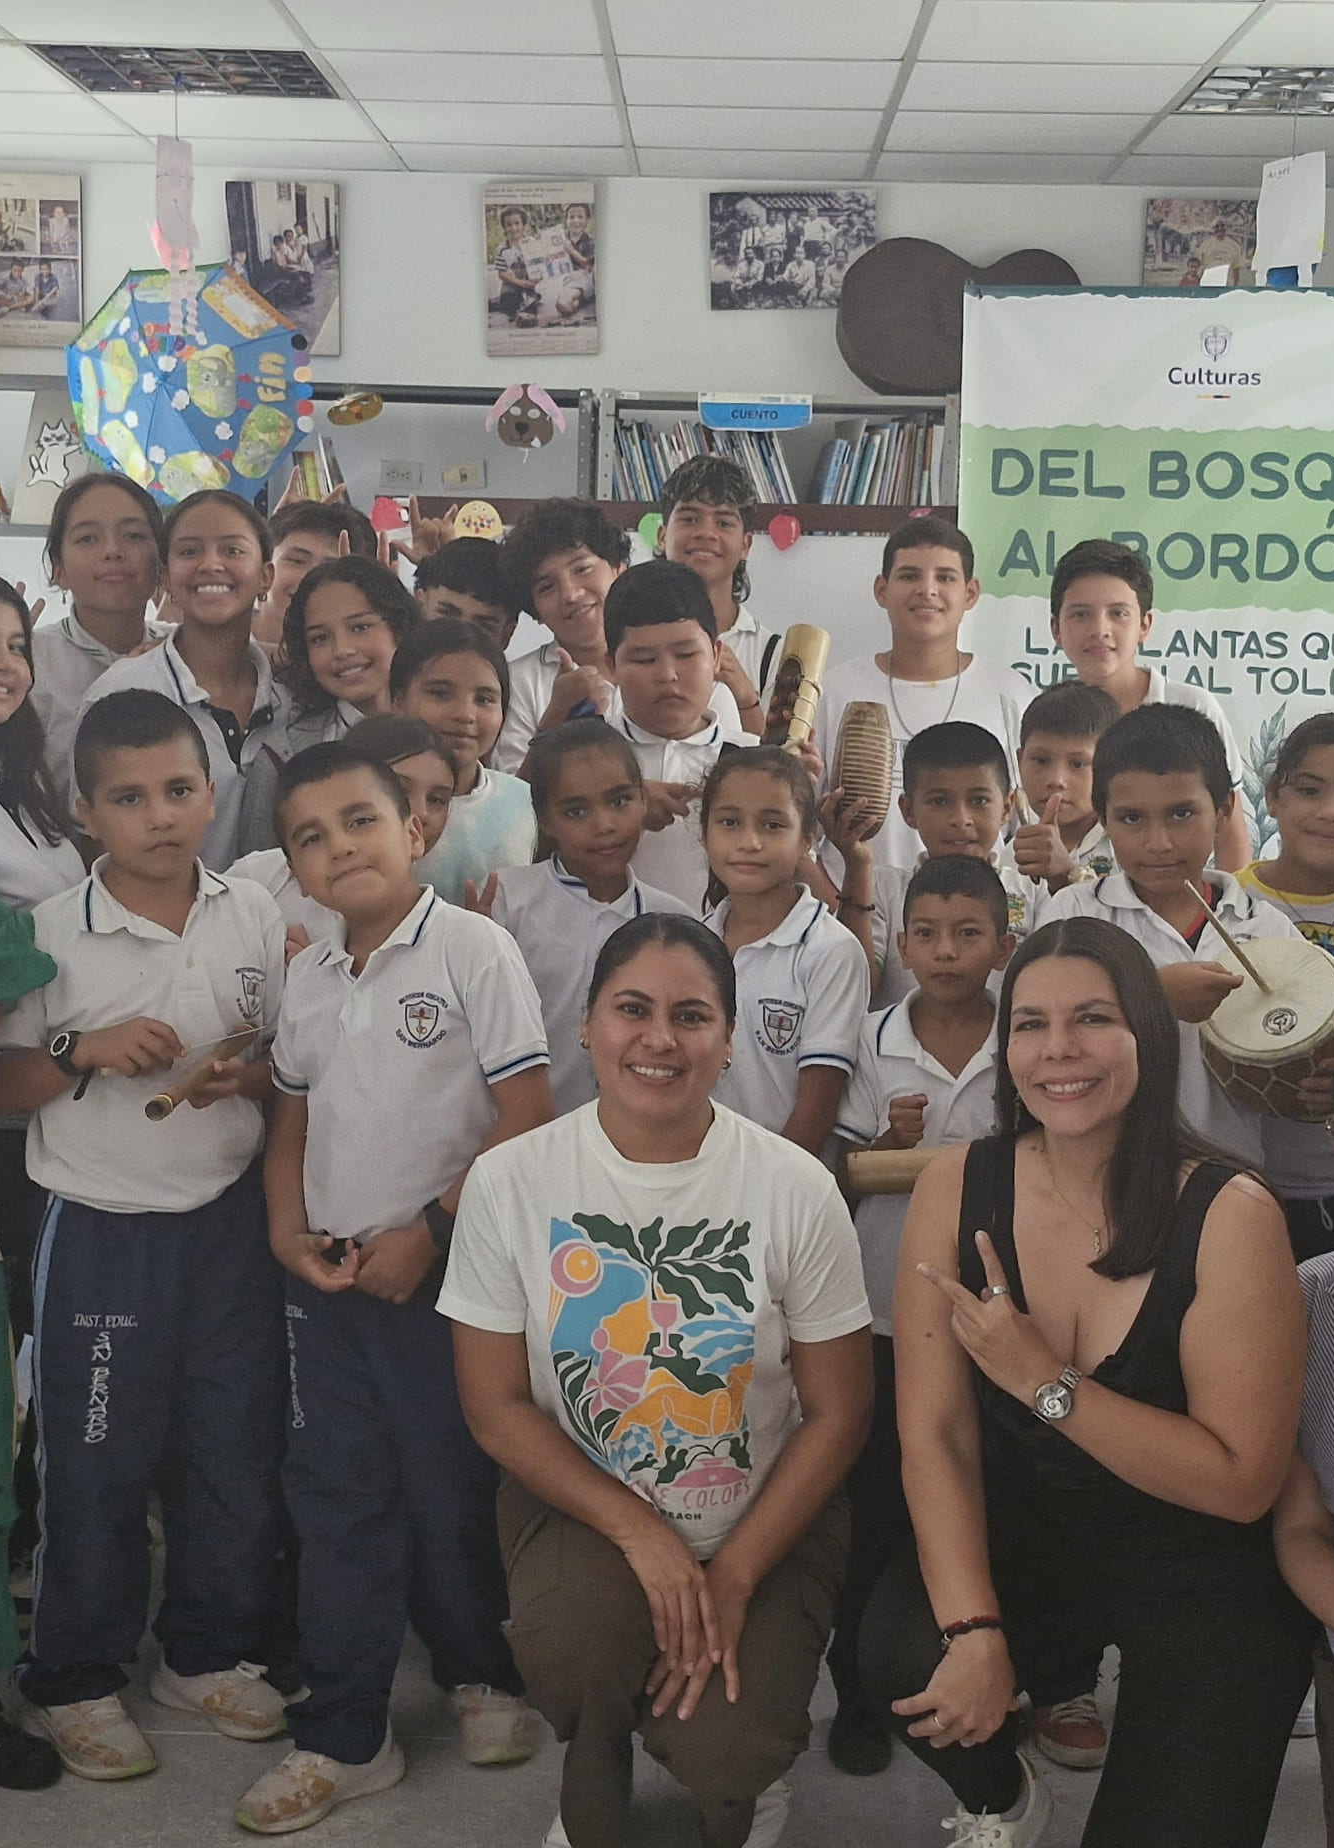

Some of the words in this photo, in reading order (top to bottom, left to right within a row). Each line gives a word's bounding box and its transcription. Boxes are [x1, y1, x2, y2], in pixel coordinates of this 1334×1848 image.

[1168, 366, 1262, 387] Culturas
[731, 410, 779, 420] CUENTO
[991, 448, 1125, 499] DEL
[998, 529, 1059, 578] AL
[1136, 630, 1288, 659] LANTAS
[1184, 665, 1233, 695] AL
[105, 1314, 138, 1328] EDUC.
[683, 1482, 751, 1510] COLORS
